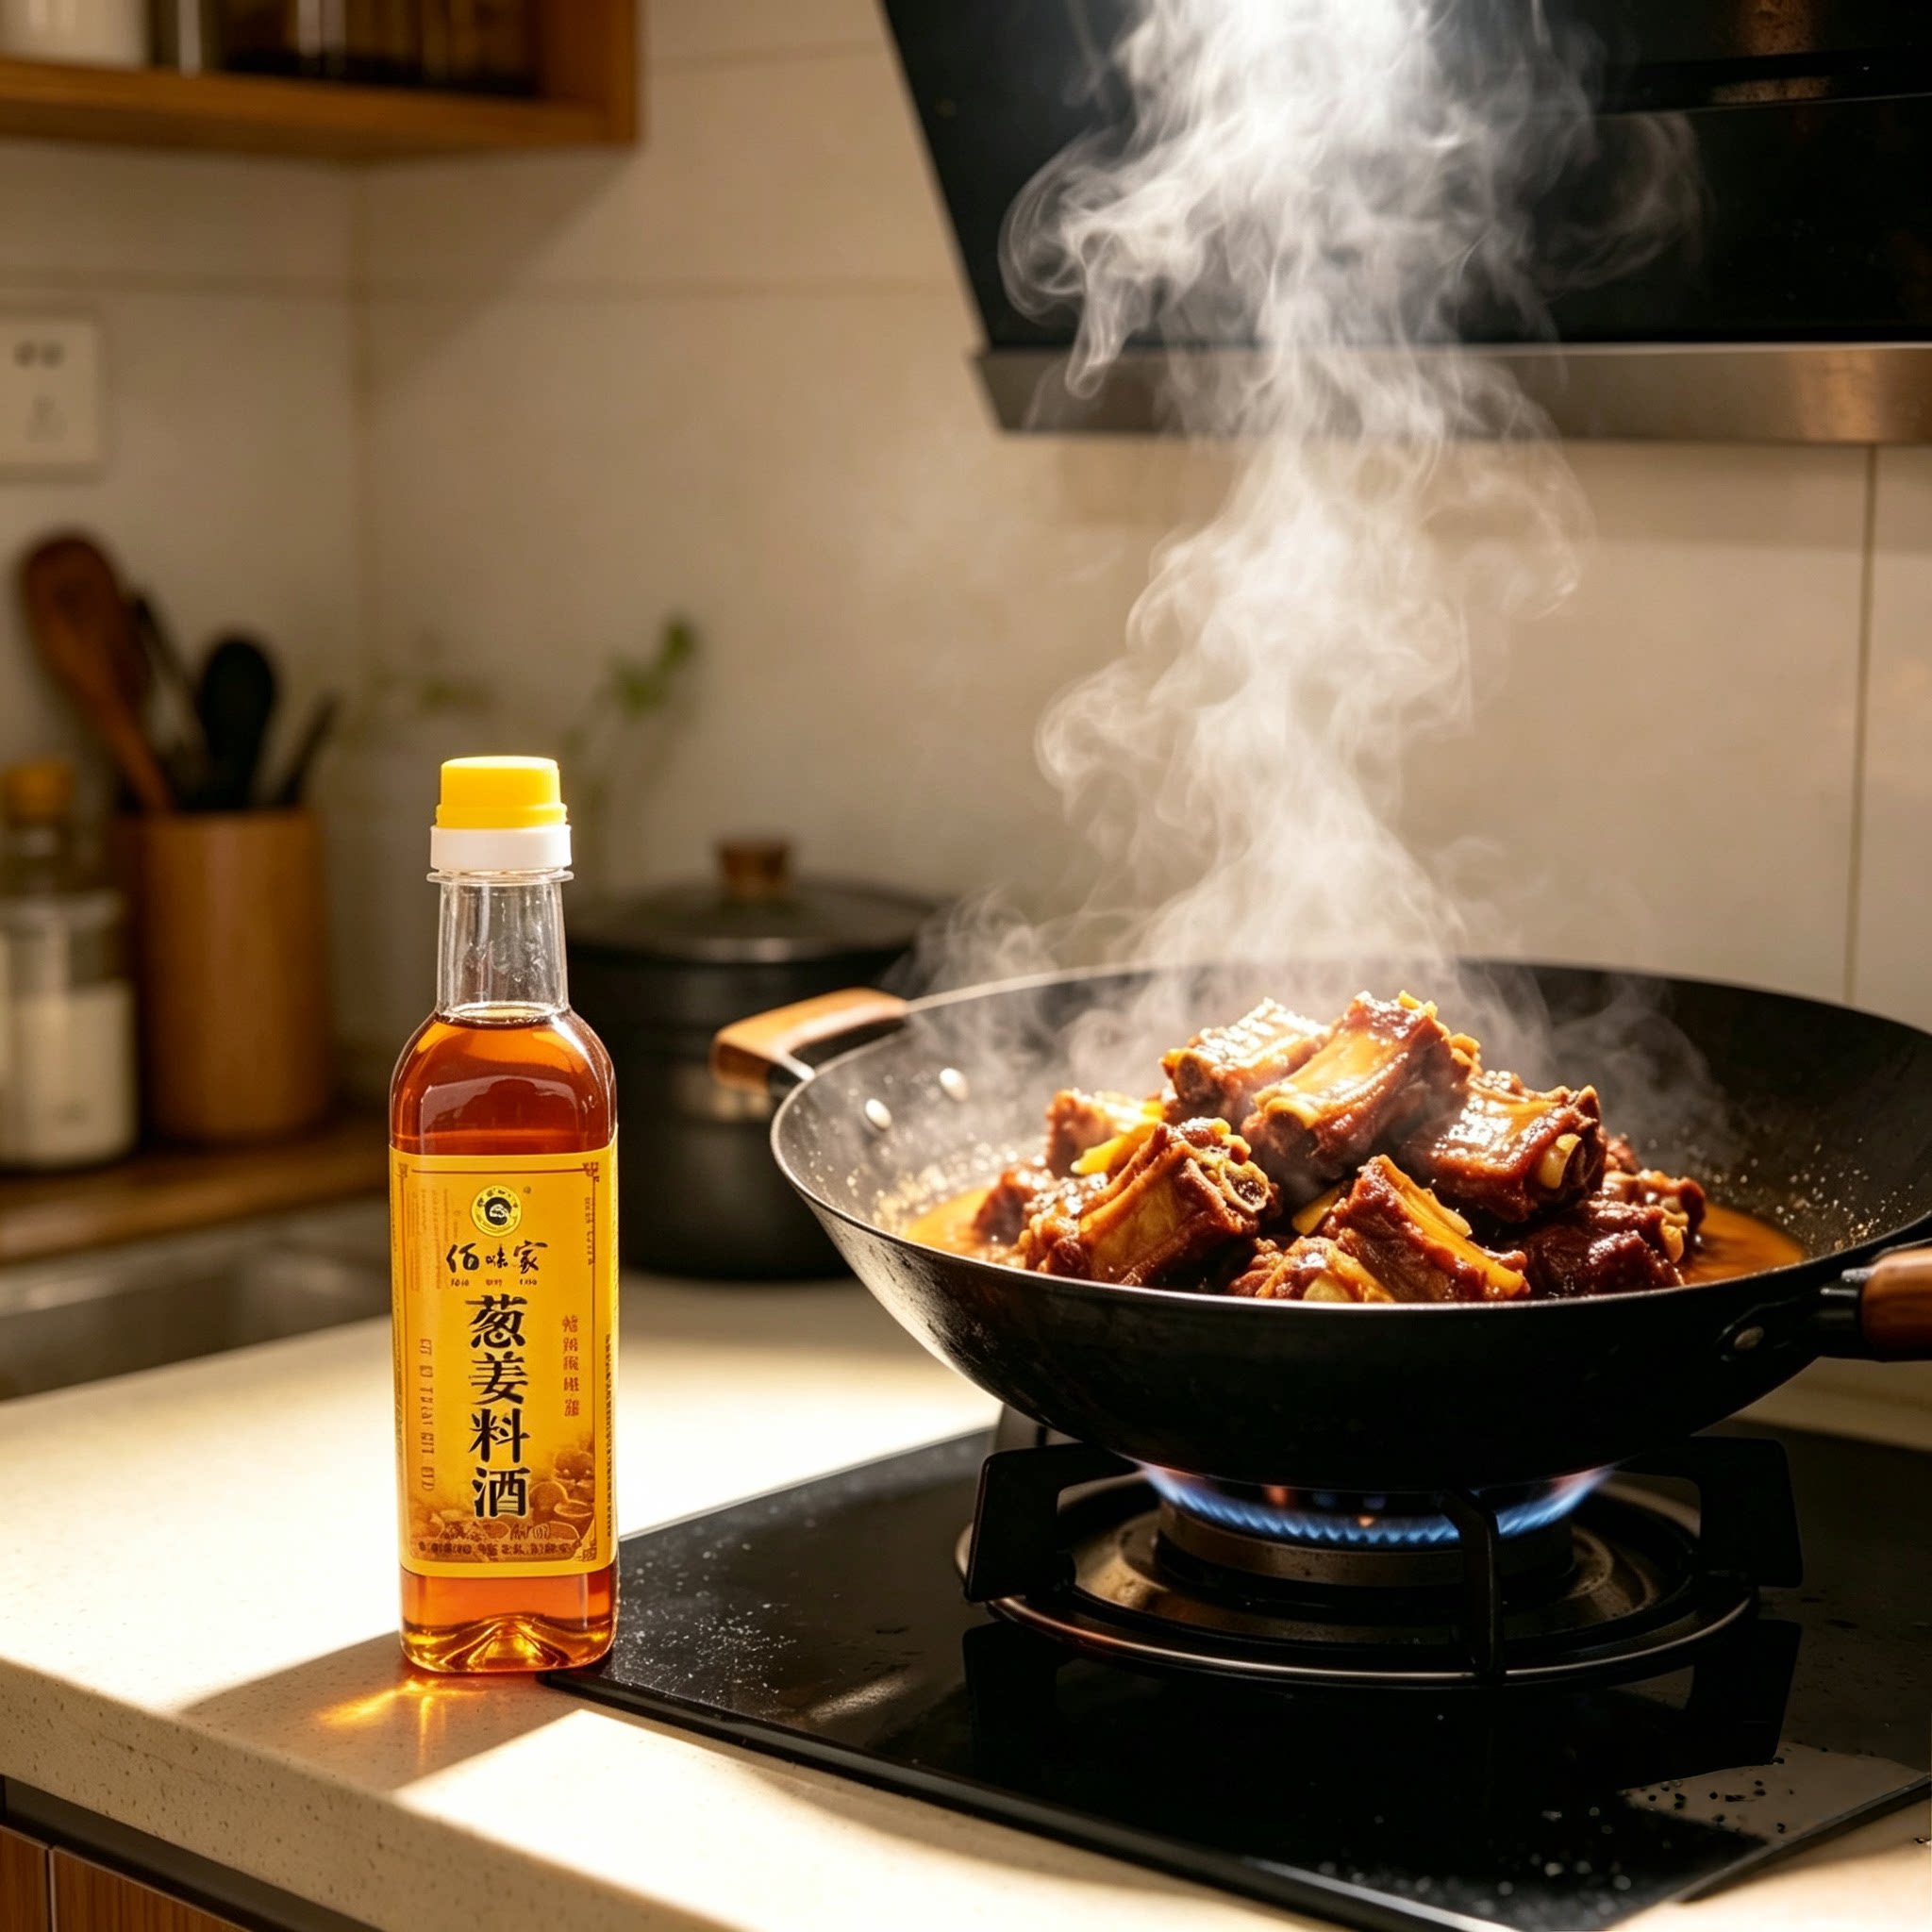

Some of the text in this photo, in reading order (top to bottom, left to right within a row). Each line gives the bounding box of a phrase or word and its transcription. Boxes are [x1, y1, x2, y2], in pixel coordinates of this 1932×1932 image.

[446, 1241, 548, 1274] 佰味家
[465, 1293, 530, 1518] 葱姜料酒
